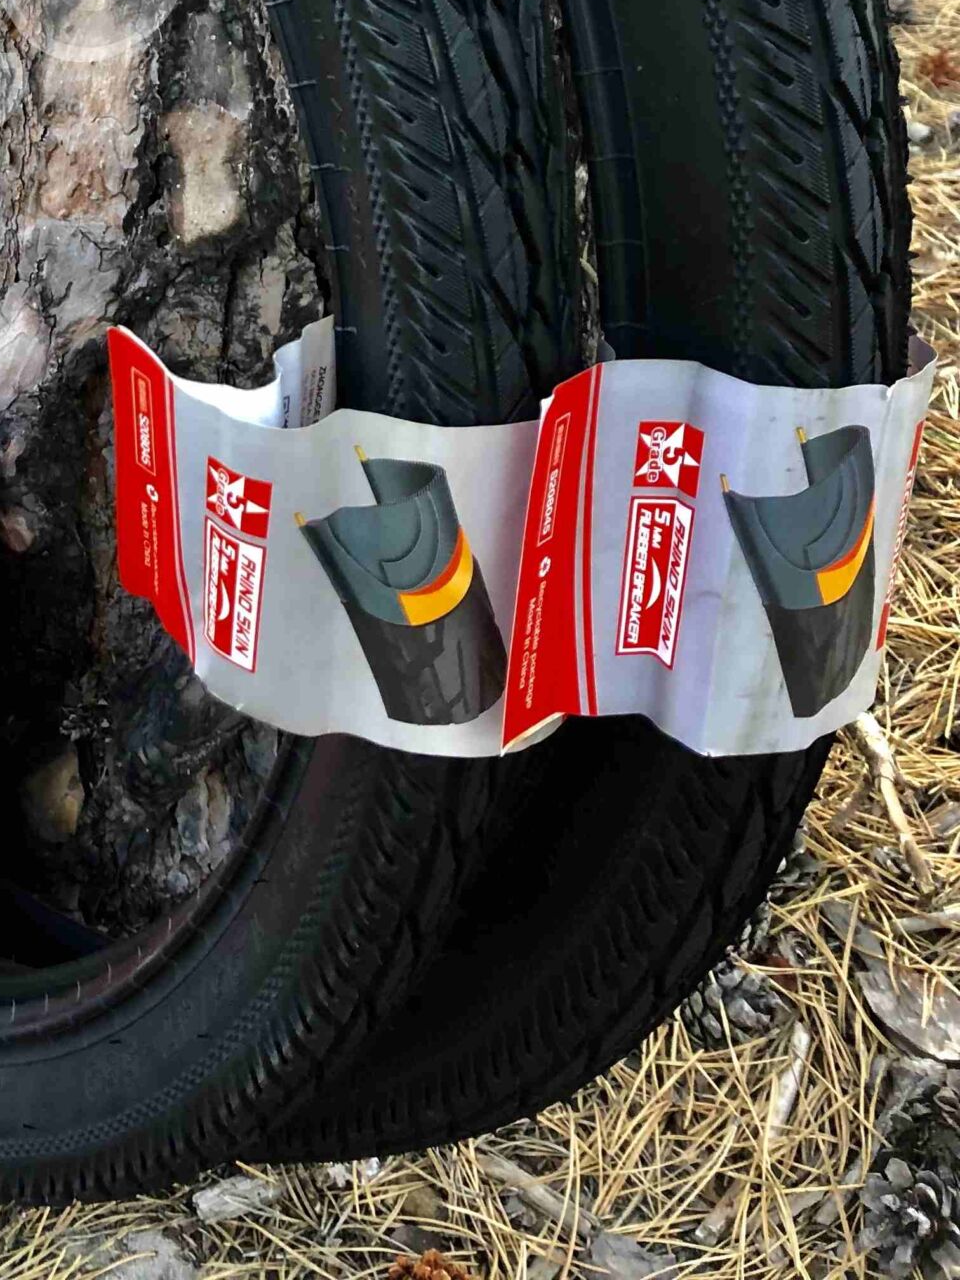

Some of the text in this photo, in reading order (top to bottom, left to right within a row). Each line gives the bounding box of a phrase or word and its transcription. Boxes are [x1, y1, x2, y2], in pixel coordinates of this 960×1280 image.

[647, 426, 666, 484] Grade
[542, 468, 559, 536] S208045
[234, 553, 257, 659] RHINO SKIN
[525, 596, 537, 634] Made
[626, 507, 652, 645] RUBBER BREAKER
[660, 514, 686, 651] RHINO SKIN
